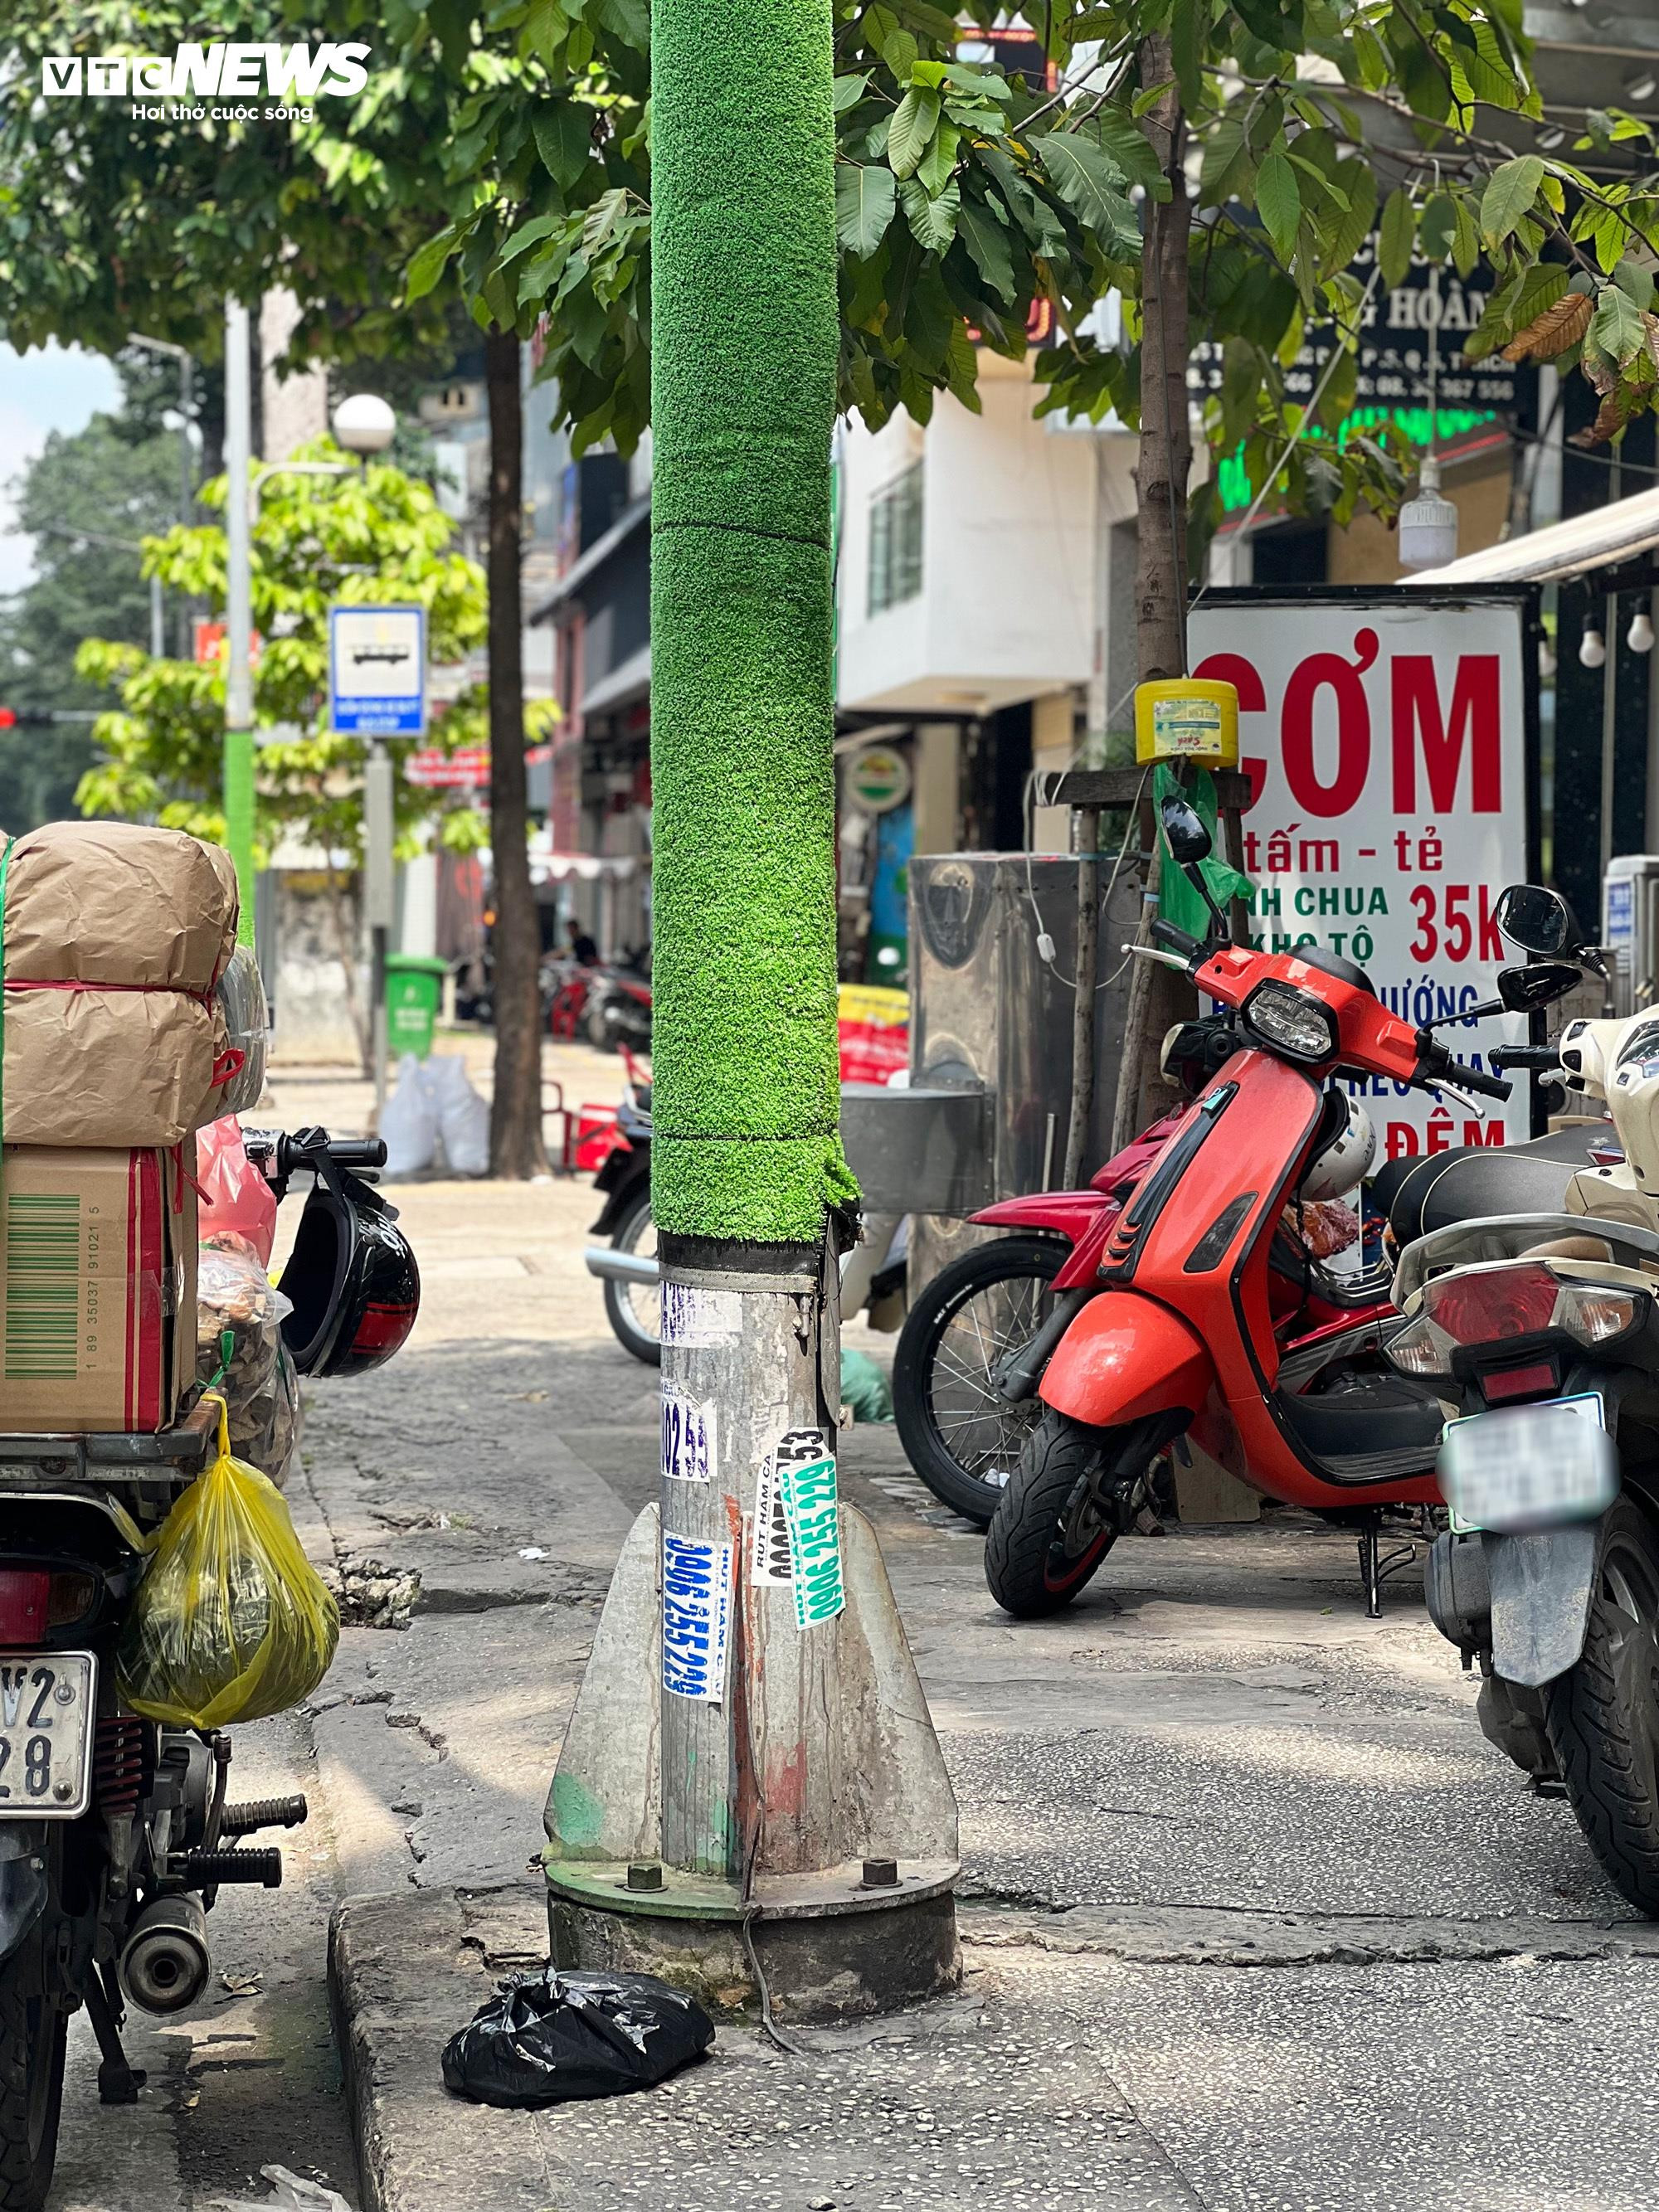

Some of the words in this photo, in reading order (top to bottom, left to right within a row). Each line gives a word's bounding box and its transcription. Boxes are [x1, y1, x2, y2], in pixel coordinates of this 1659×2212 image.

[1243, 824, 1339, 873] tấm
[1394, 825, 1443, 872] tẻ
[1294, 887, 1389, 916] CHUA
[1328, 925, 1374, 968] TỘ
[88, 1226, 100, 1270] 91021
[87, 1281, 99, 1325] 35037
[86, 1334, 97, 1353] 89
